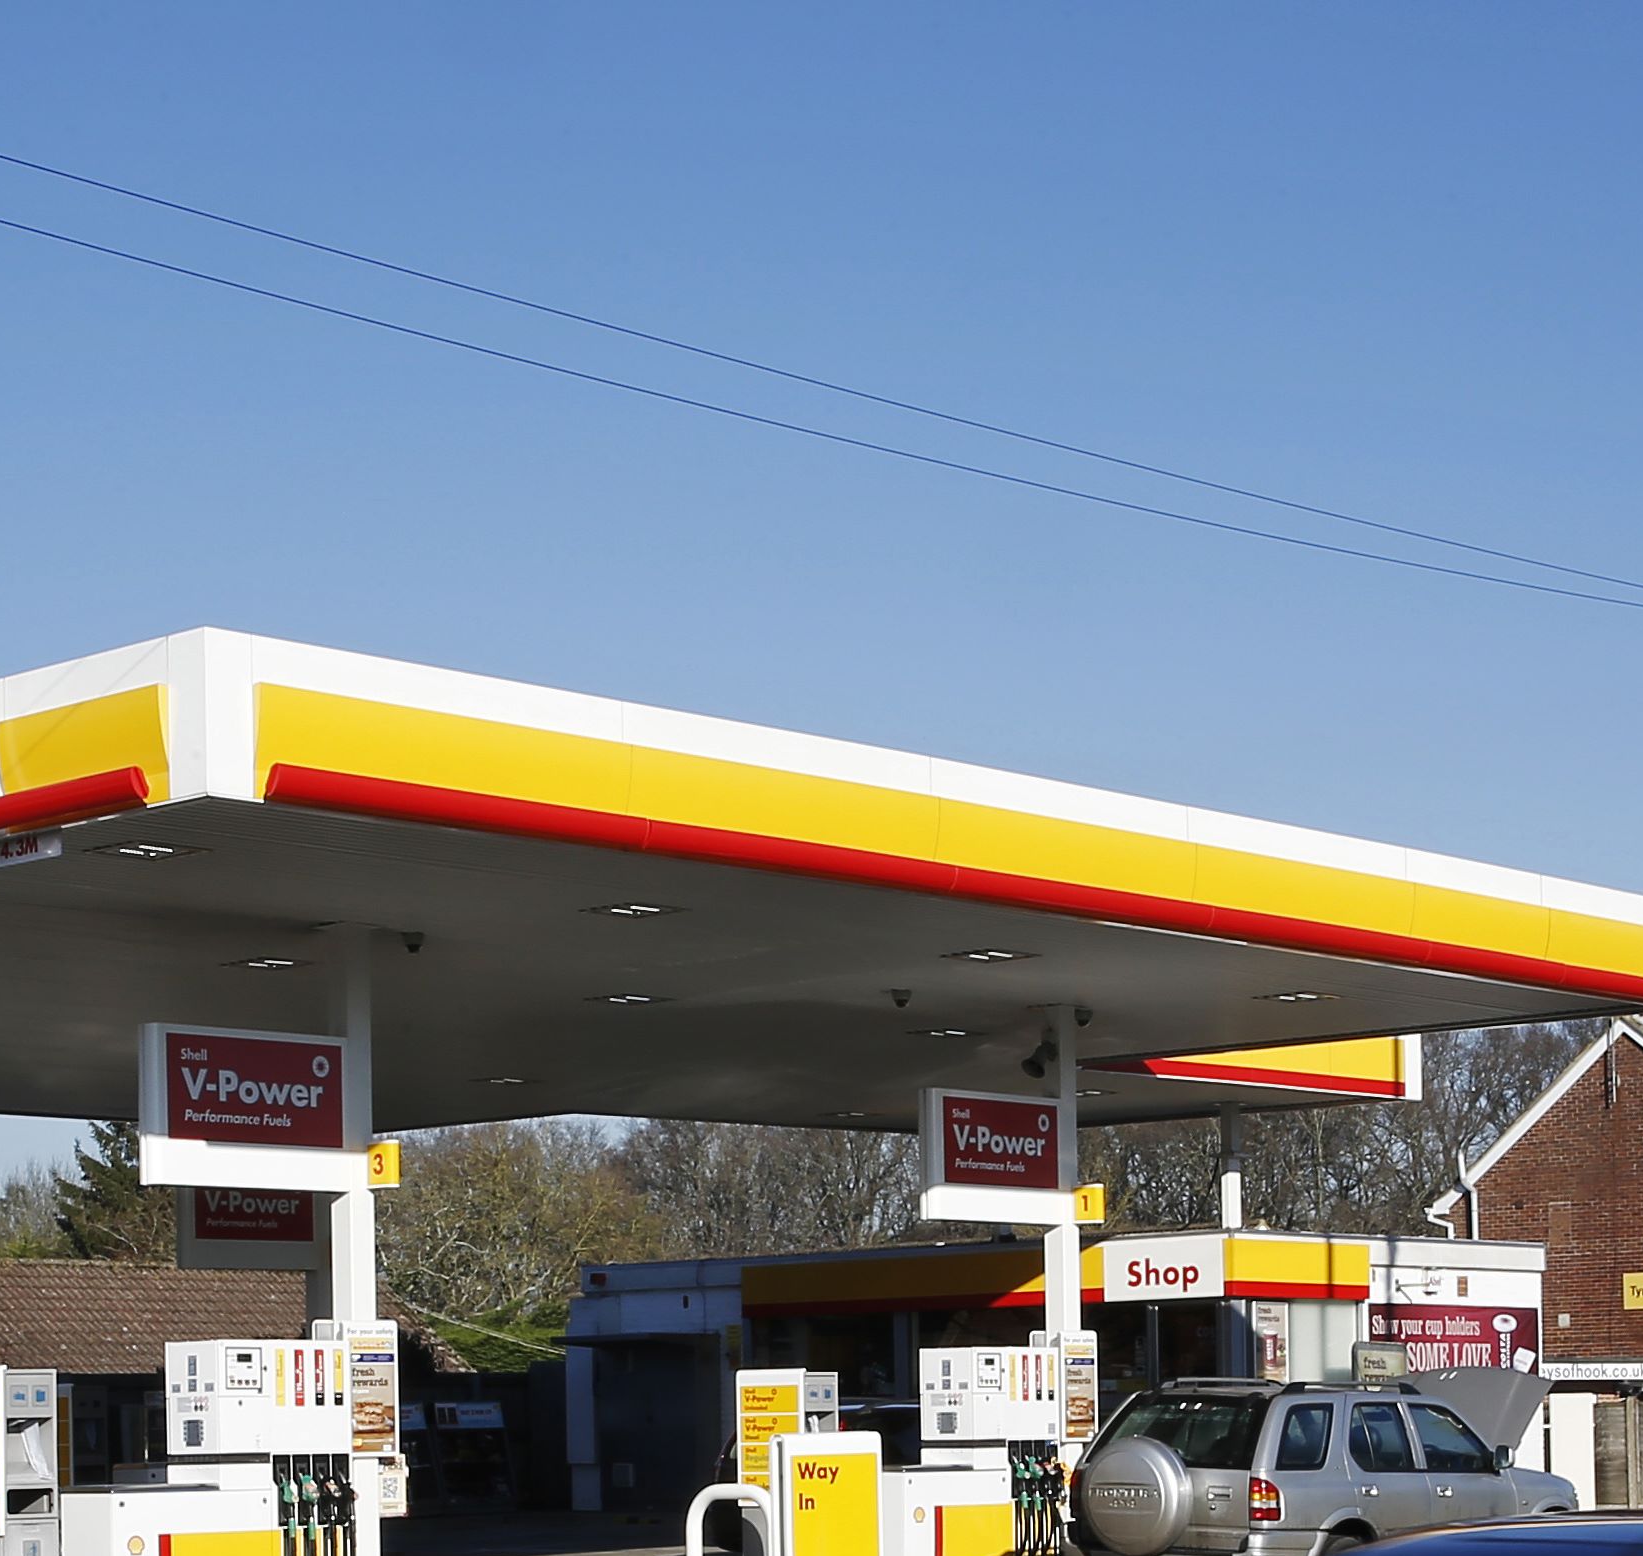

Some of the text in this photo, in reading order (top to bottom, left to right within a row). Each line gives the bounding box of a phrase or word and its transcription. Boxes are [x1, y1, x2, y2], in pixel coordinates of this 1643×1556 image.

[180, 1048, 207, 1061] Shell
[181, 1067, 323, 1108] V-Power
[184, 1109, 292, 1127] Performance Fuels
[952, 1108, 970, 1120] Shell
[953, 1123, 1045, 1157] V-Power
[372, 1153, 384, 1175] 3
[955, 1158, 1025, 1173] Performance Fuels
[205, 1190, 300, 1214] V-Power
[1082, 1195, 1089, 1211] 1
[1127, 1257, 1199, 1292] Shop
[1400, 1318, 1423, 1340] your
[1425, 1319, 1443, 1340] cup
[1445, 1317, 1481, 1337] holders
[1407, 1342, 1450, 1373] SOME
[1451, 1343, 1492, 1369] LOVE
[352, 1368, 375, 1377] fresh
[352, 1377, 388, 1387] rewards
[745, 1424, 775, 1432] V-Power
[797, 1462, 839, 1484] Way
[799, 1493, 815, 1510] In
